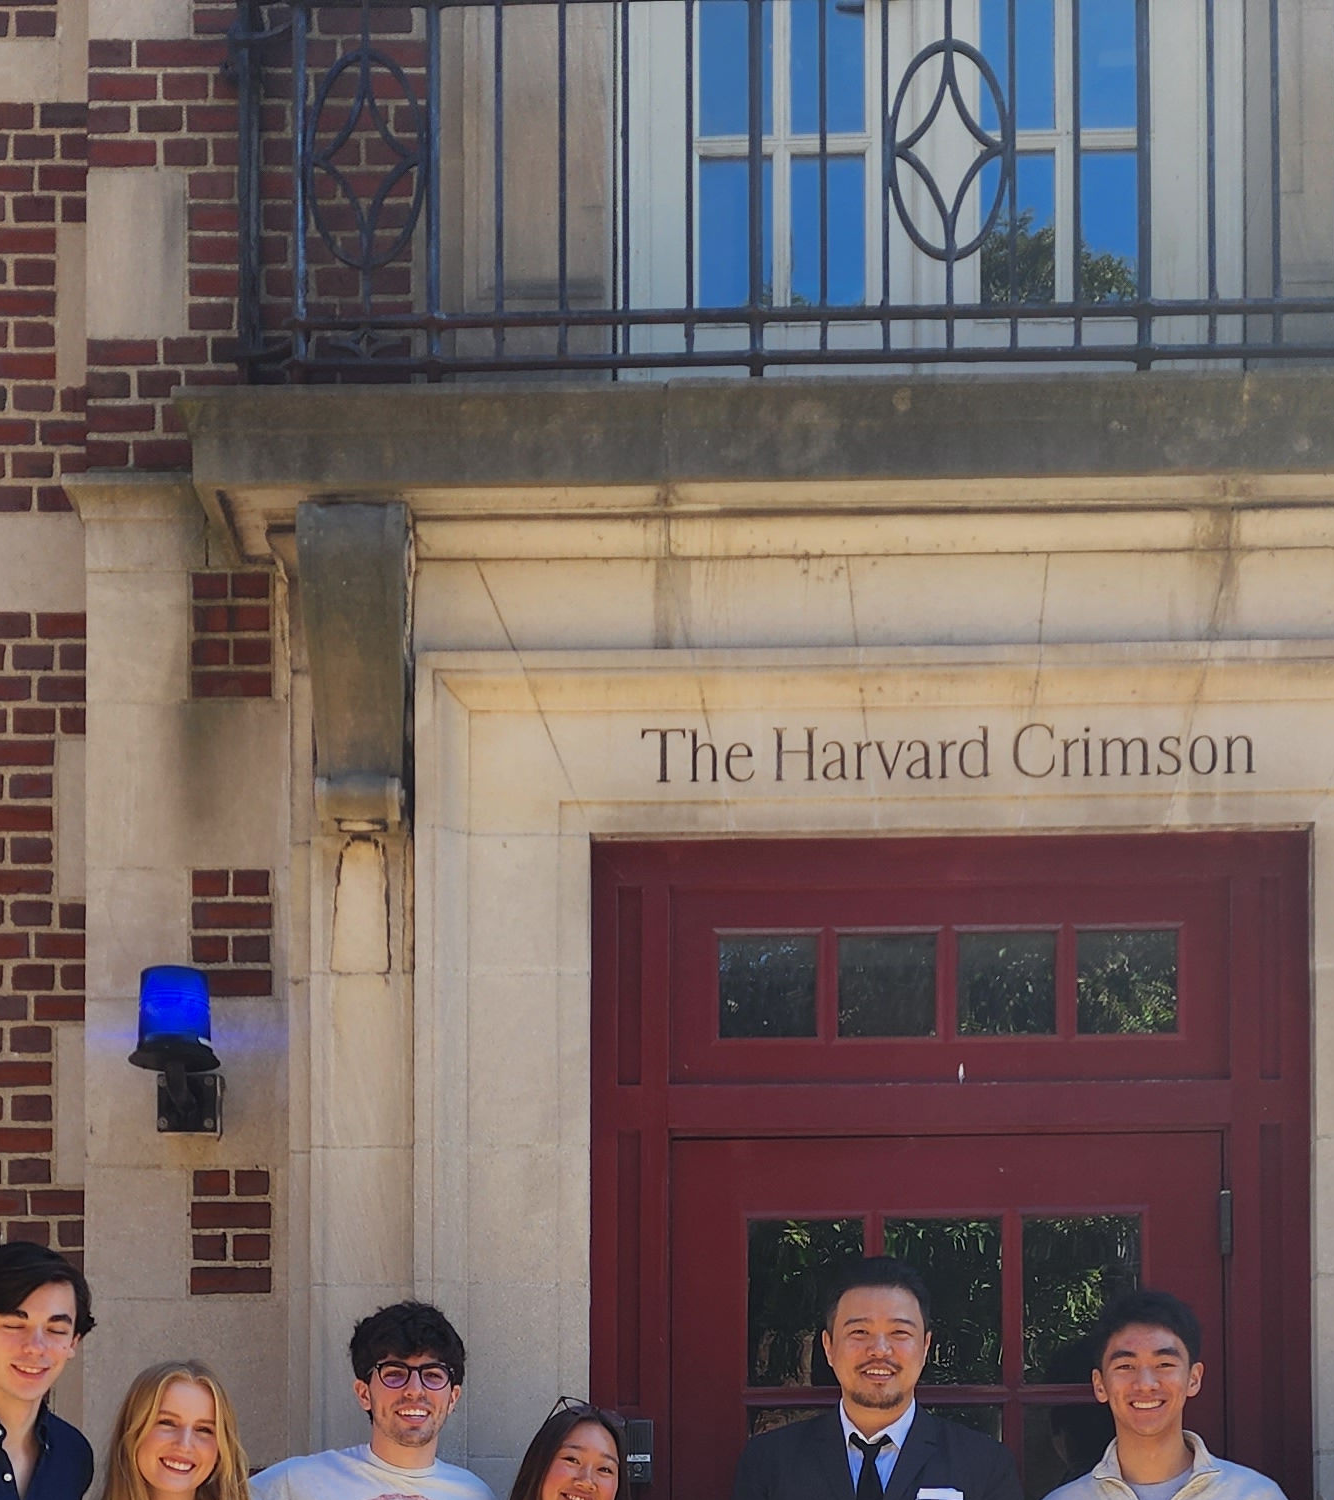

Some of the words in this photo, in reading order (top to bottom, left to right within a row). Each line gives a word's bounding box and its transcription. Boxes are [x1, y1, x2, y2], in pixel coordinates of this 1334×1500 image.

[640, 728, 755, 783] The
[772, 726, 992, 782] Harvard
[1012, 723, 1257, 778] Crimson
